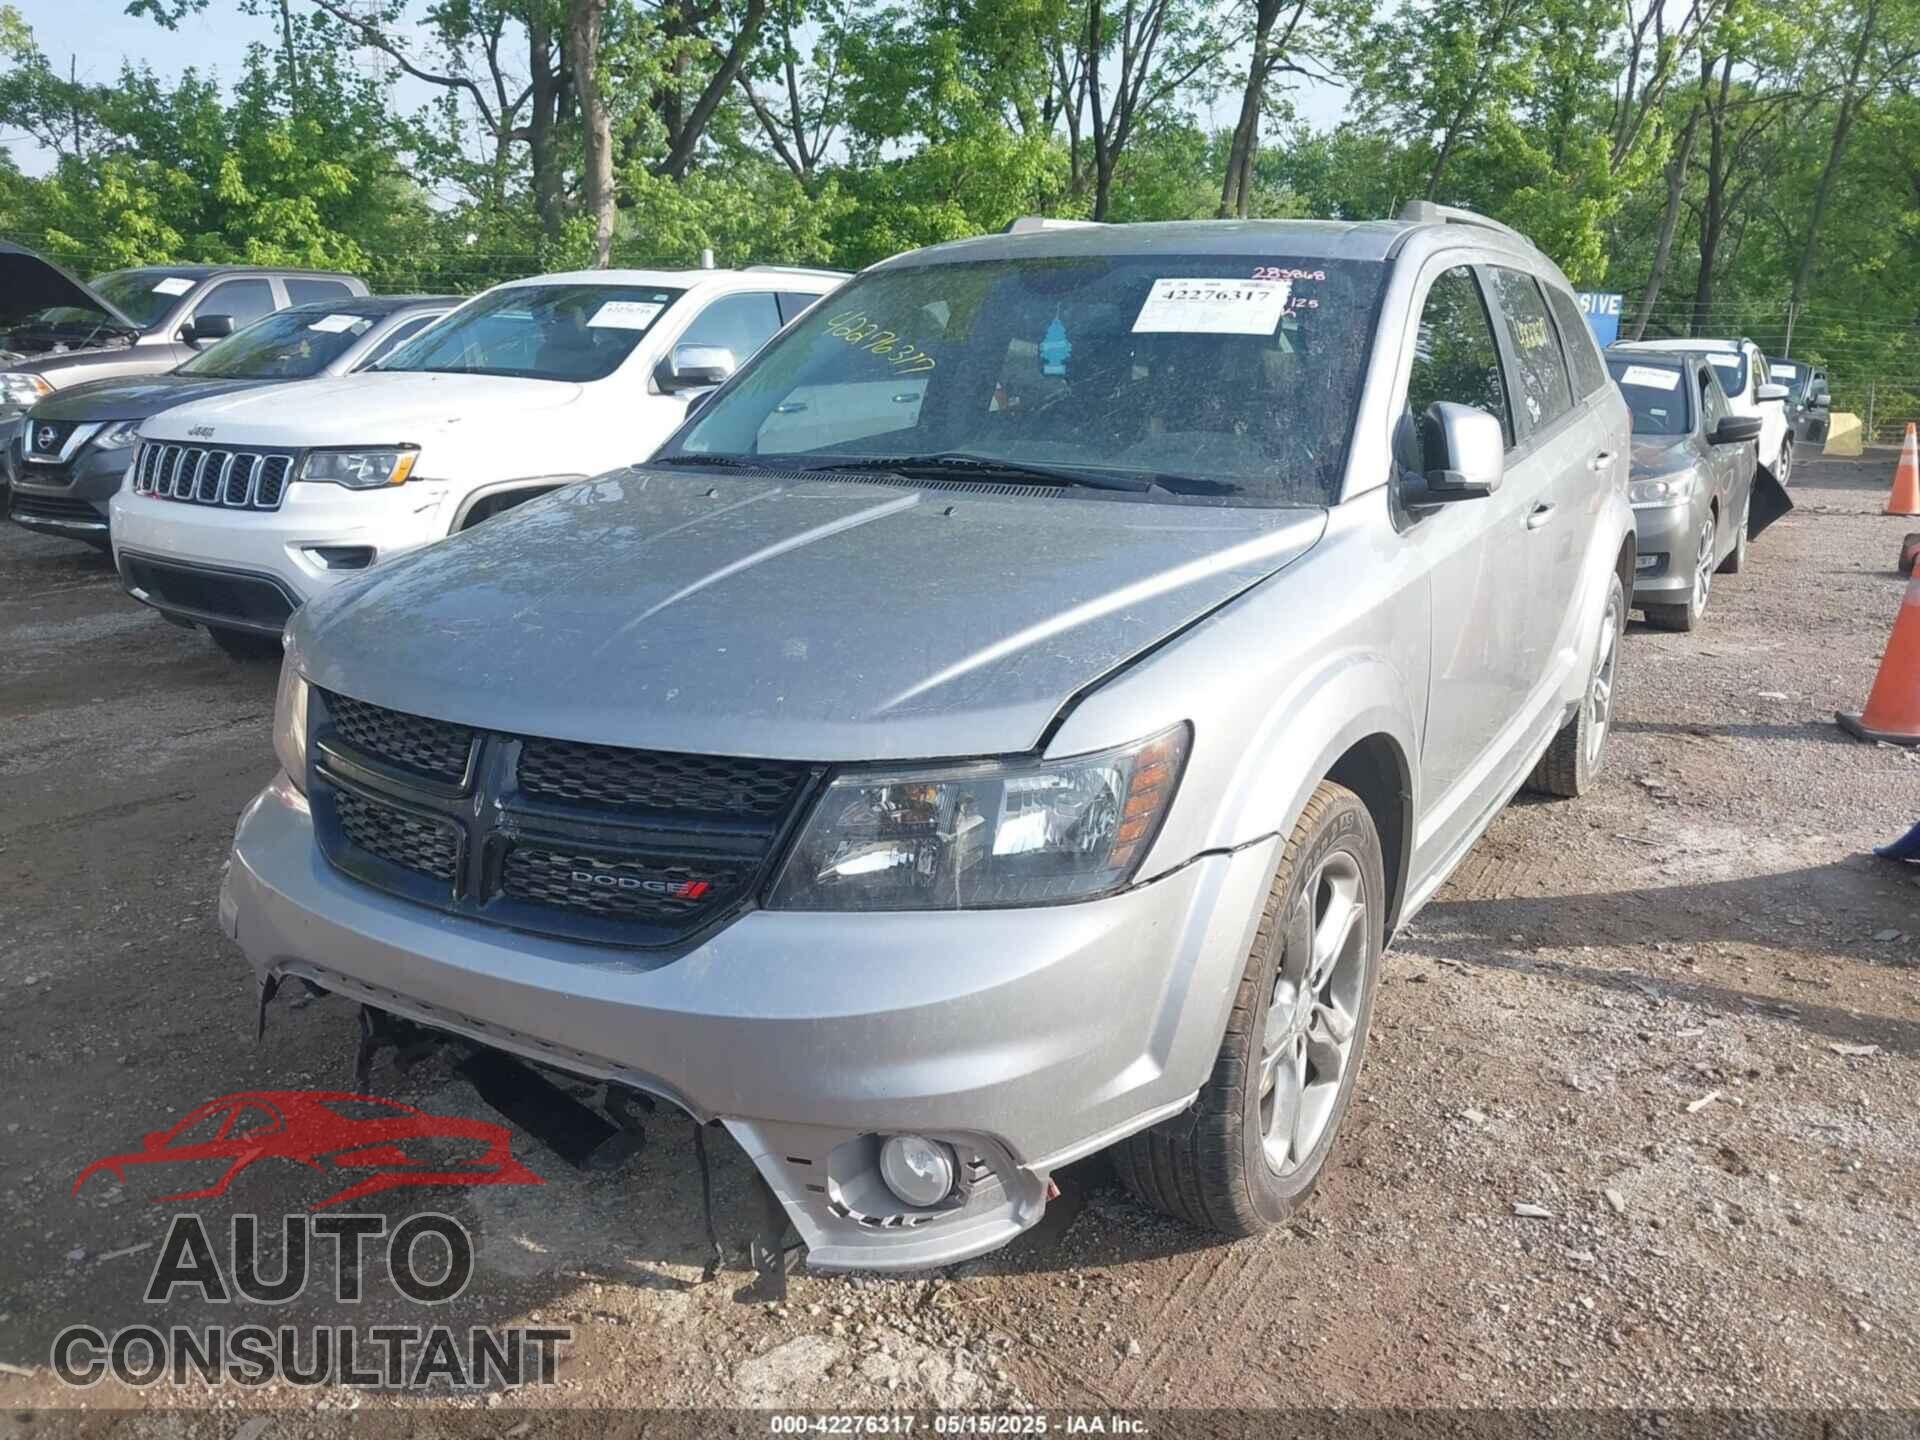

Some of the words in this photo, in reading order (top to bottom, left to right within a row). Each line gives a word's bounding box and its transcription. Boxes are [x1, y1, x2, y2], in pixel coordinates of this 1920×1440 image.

[1161, 288, 1271, 301] 42276317
[1580, 293, 1623, 315] SIVE
[187, 423, 216, 440] Jeep
[571, 871, 689, 896] DODGE
